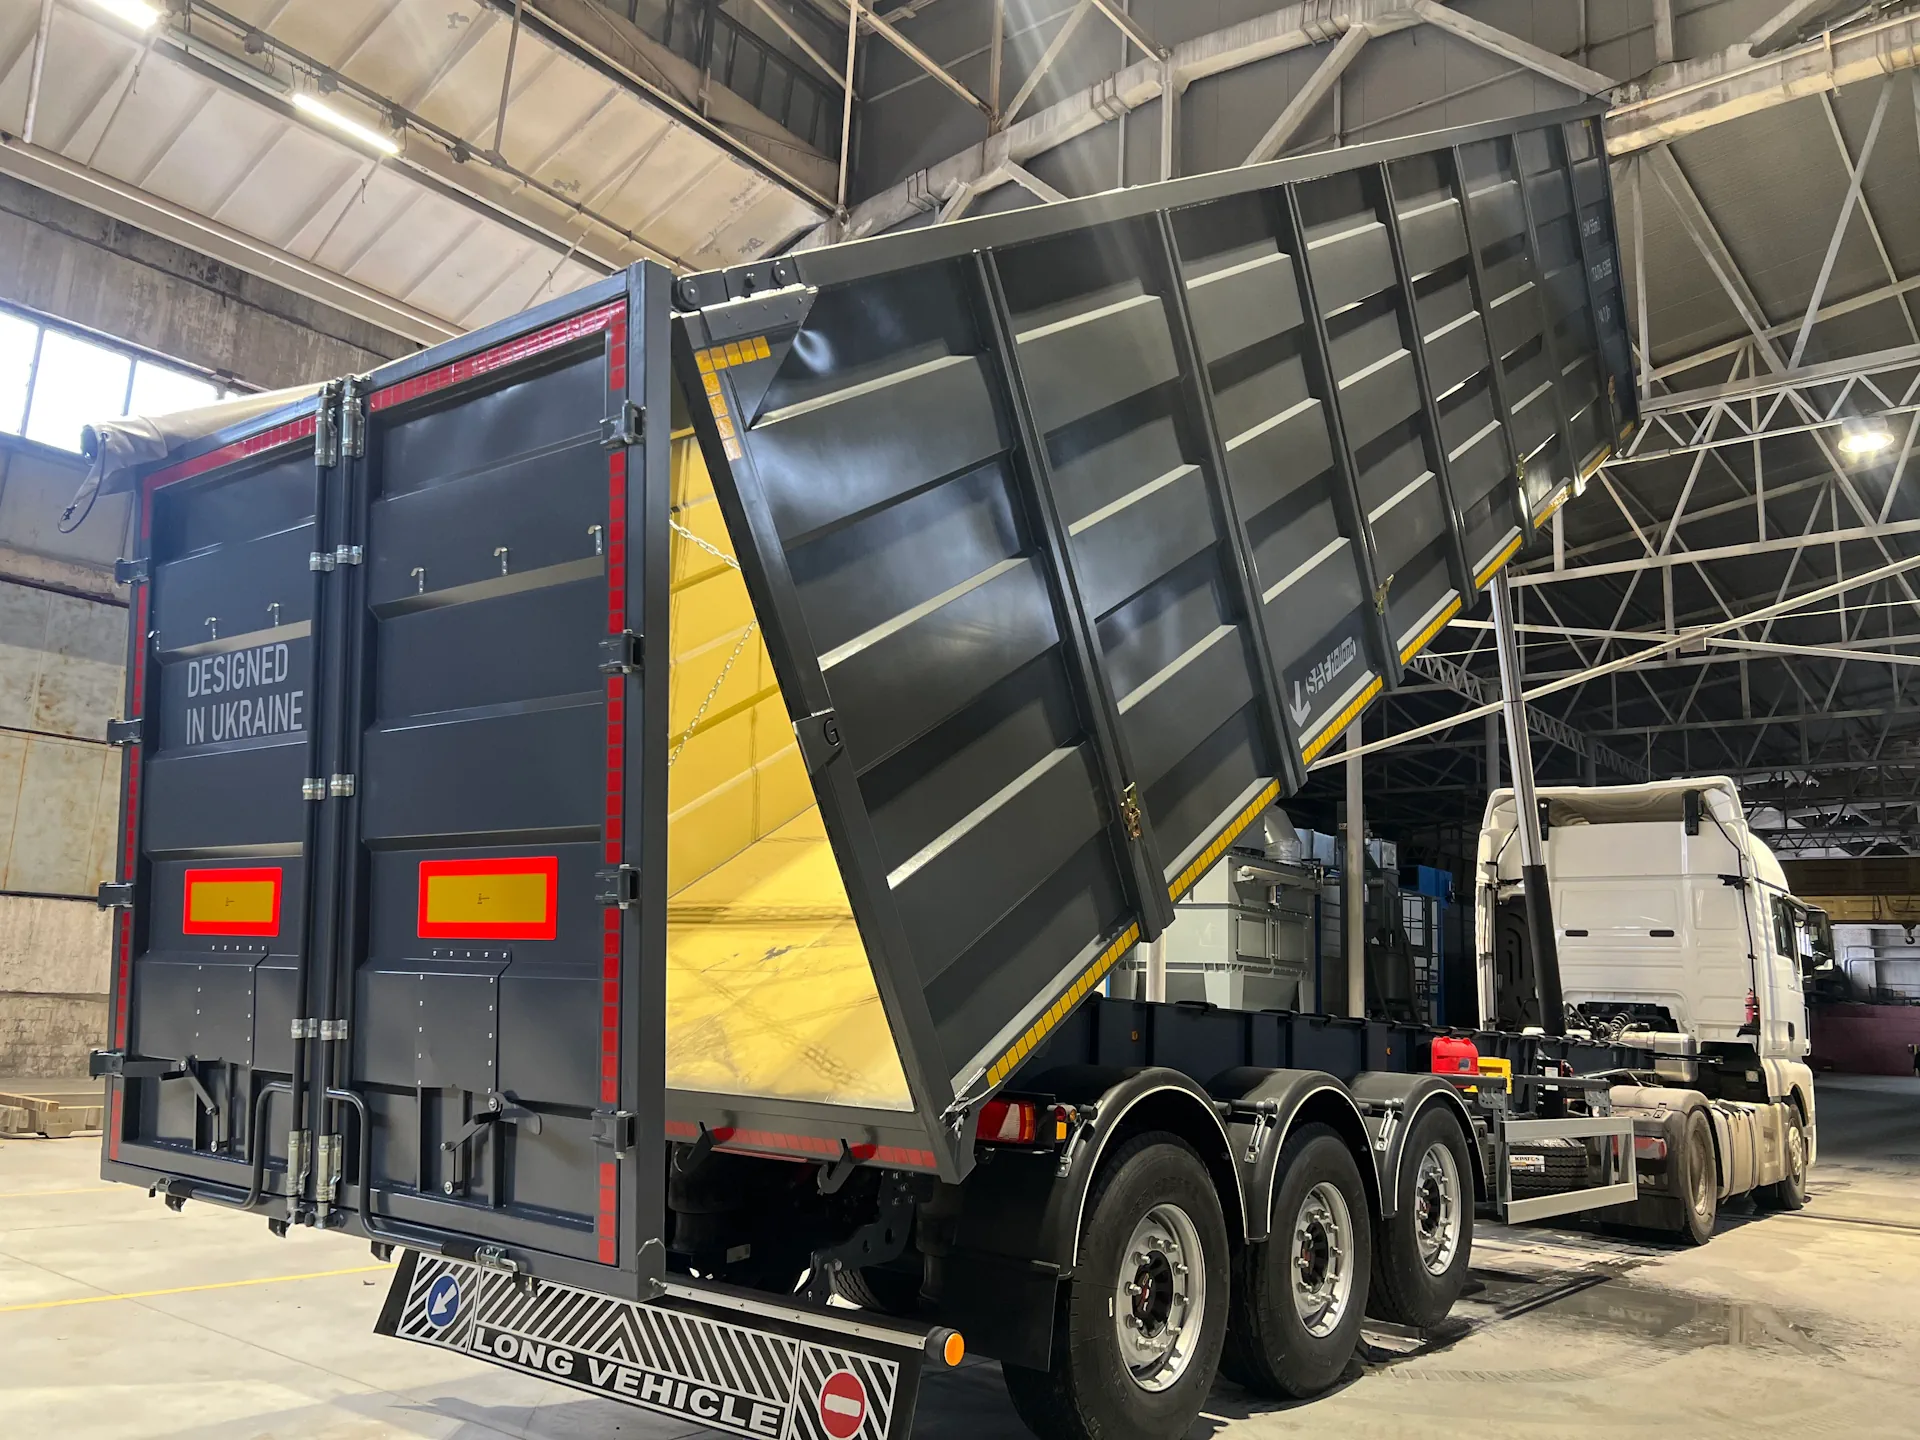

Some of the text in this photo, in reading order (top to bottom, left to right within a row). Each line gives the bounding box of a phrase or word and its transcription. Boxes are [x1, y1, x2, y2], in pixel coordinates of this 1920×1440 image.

[187, 643, 288, 698] DESIGNED
[186, 690, 304, 745] IN UKRAINE
[823, 717, 841, 746] G
[472, 1326, 781, 1436] LONG VEHICLE
